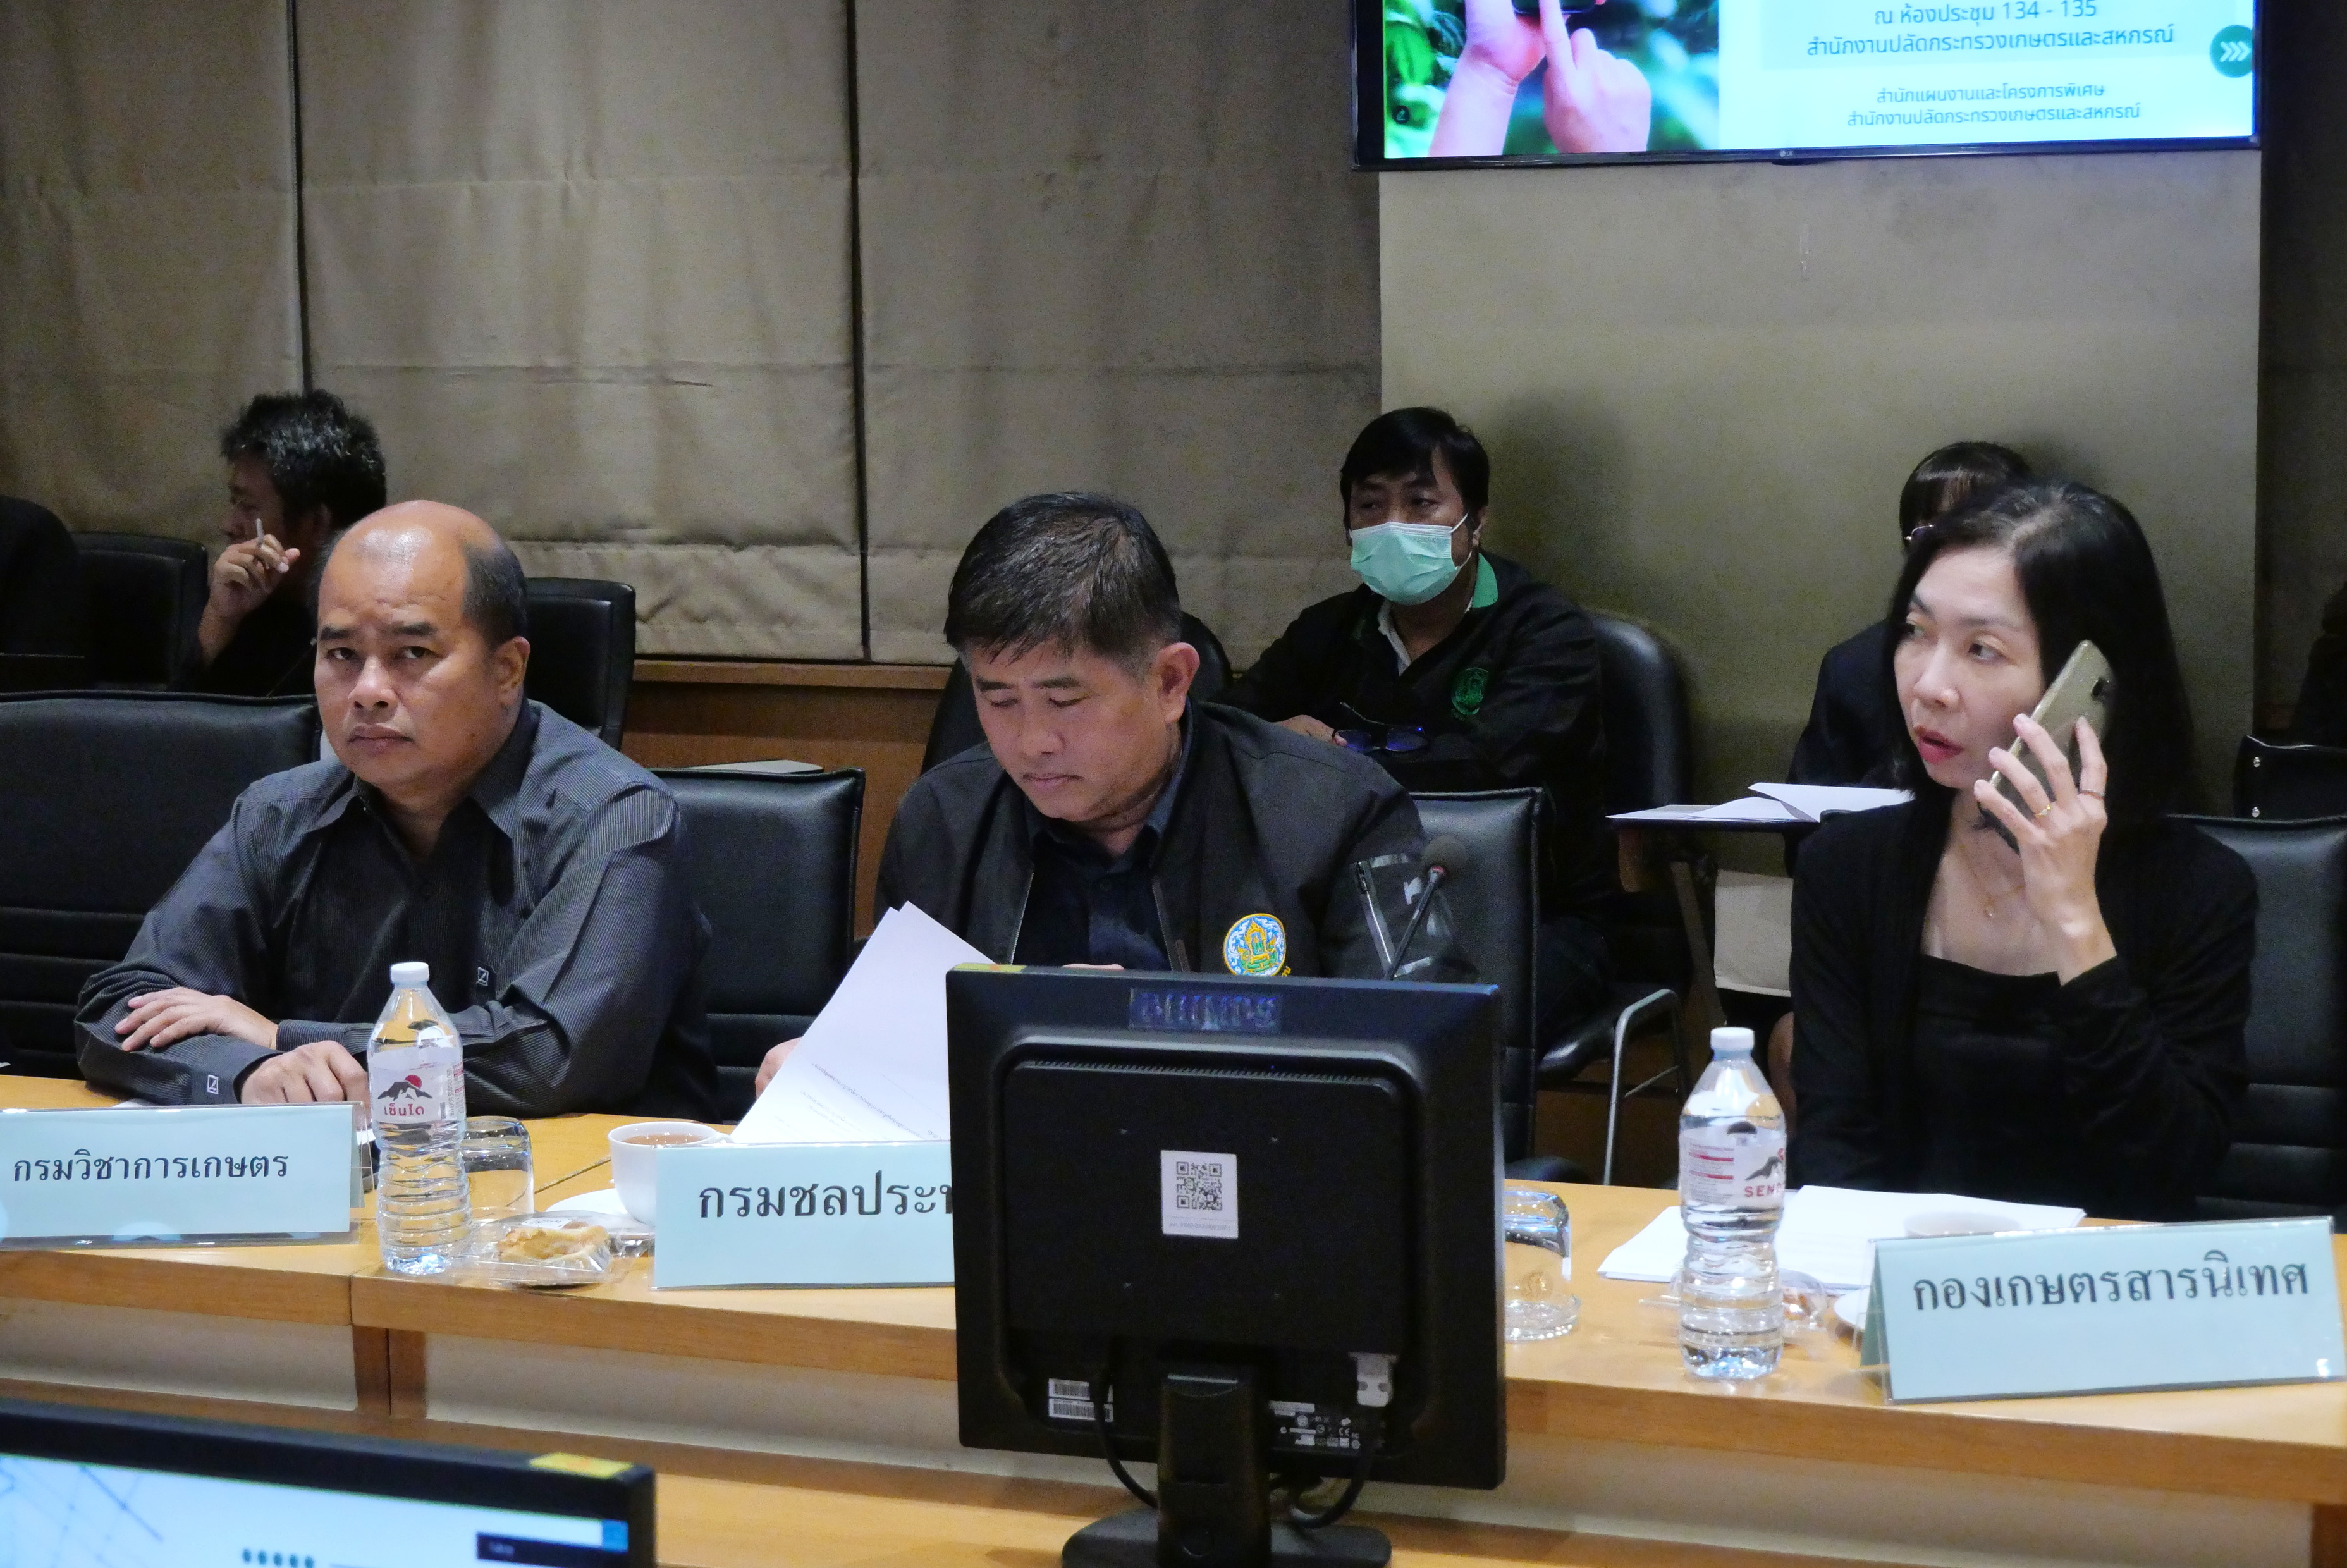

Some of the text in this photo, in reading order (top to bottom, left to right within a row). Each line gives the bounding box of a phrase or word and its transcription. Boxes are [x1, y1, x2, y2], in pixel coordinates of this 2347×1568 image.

[1875, 10, 1892, 24] ณ
[1900, 3, 1994, 27] ห้องประชุม
[2003, 1, 2039, 19] 134
[2061, 0, 2097, 18] 135
[1807, 23, 2174, 56] สำนักงานปลัดกระทรวงเกษตรและสหกรณ์
[13, 1148, 289, 1182] กรมวิชาการเกษตร
[1913, 1249, 2308, 1311] กองเกษตรสารนิเทศ
